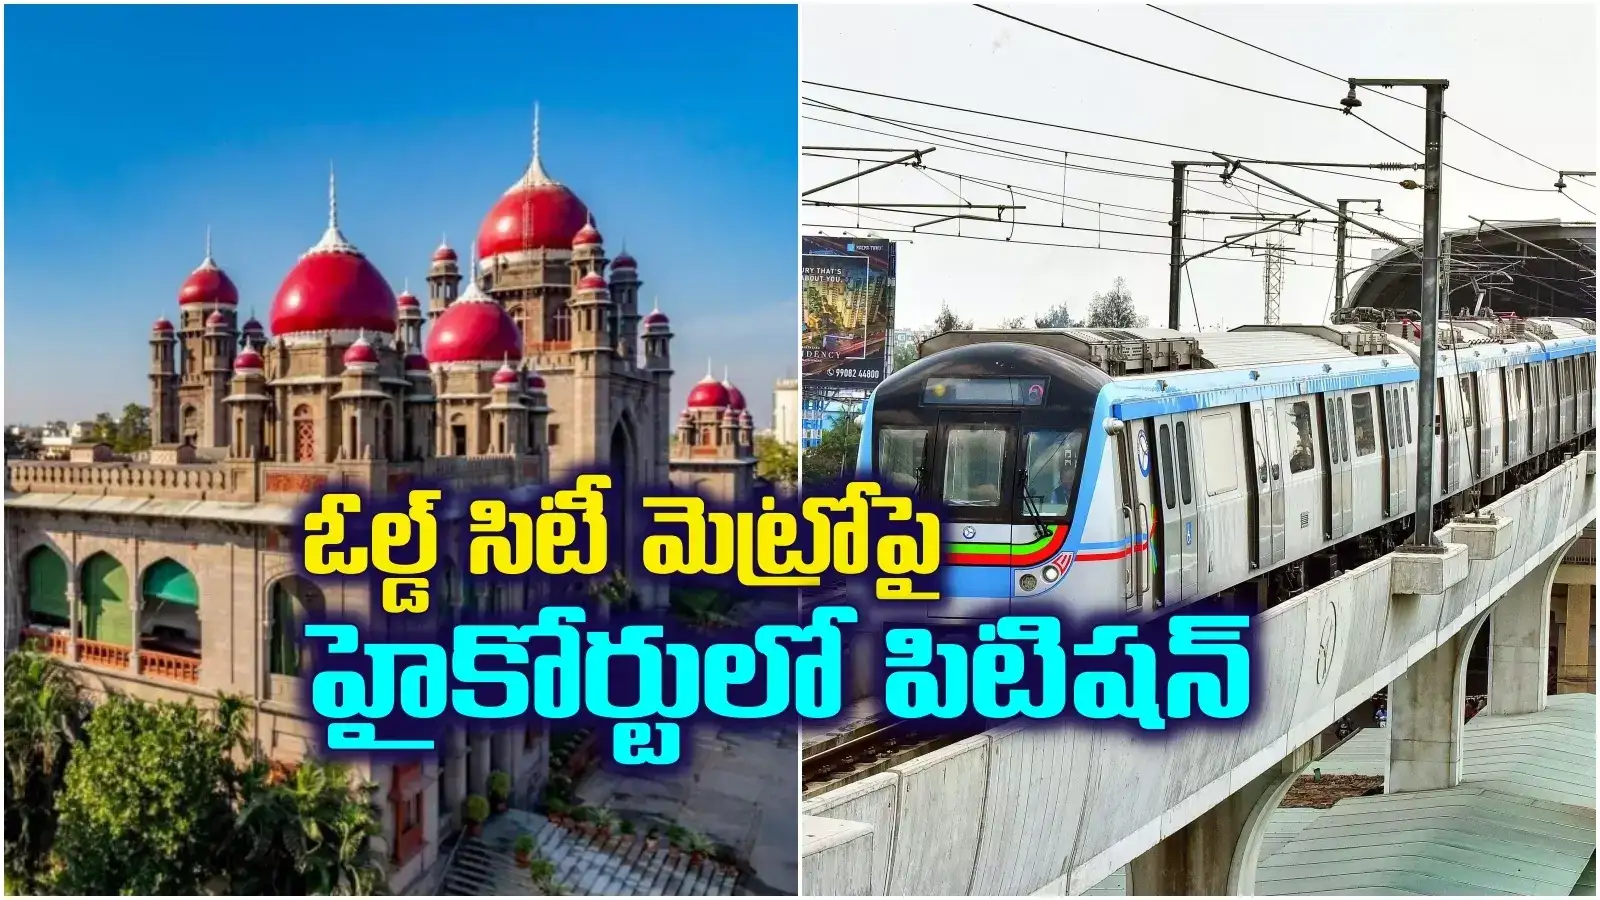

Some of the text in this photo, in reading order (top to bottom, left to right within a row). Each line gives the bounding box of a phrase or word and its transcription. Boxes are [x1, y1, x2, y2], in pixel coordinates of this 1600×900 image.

[817, 267, 842, 275] THAT'S
[835, 368, 880, 379] 99082 44800
